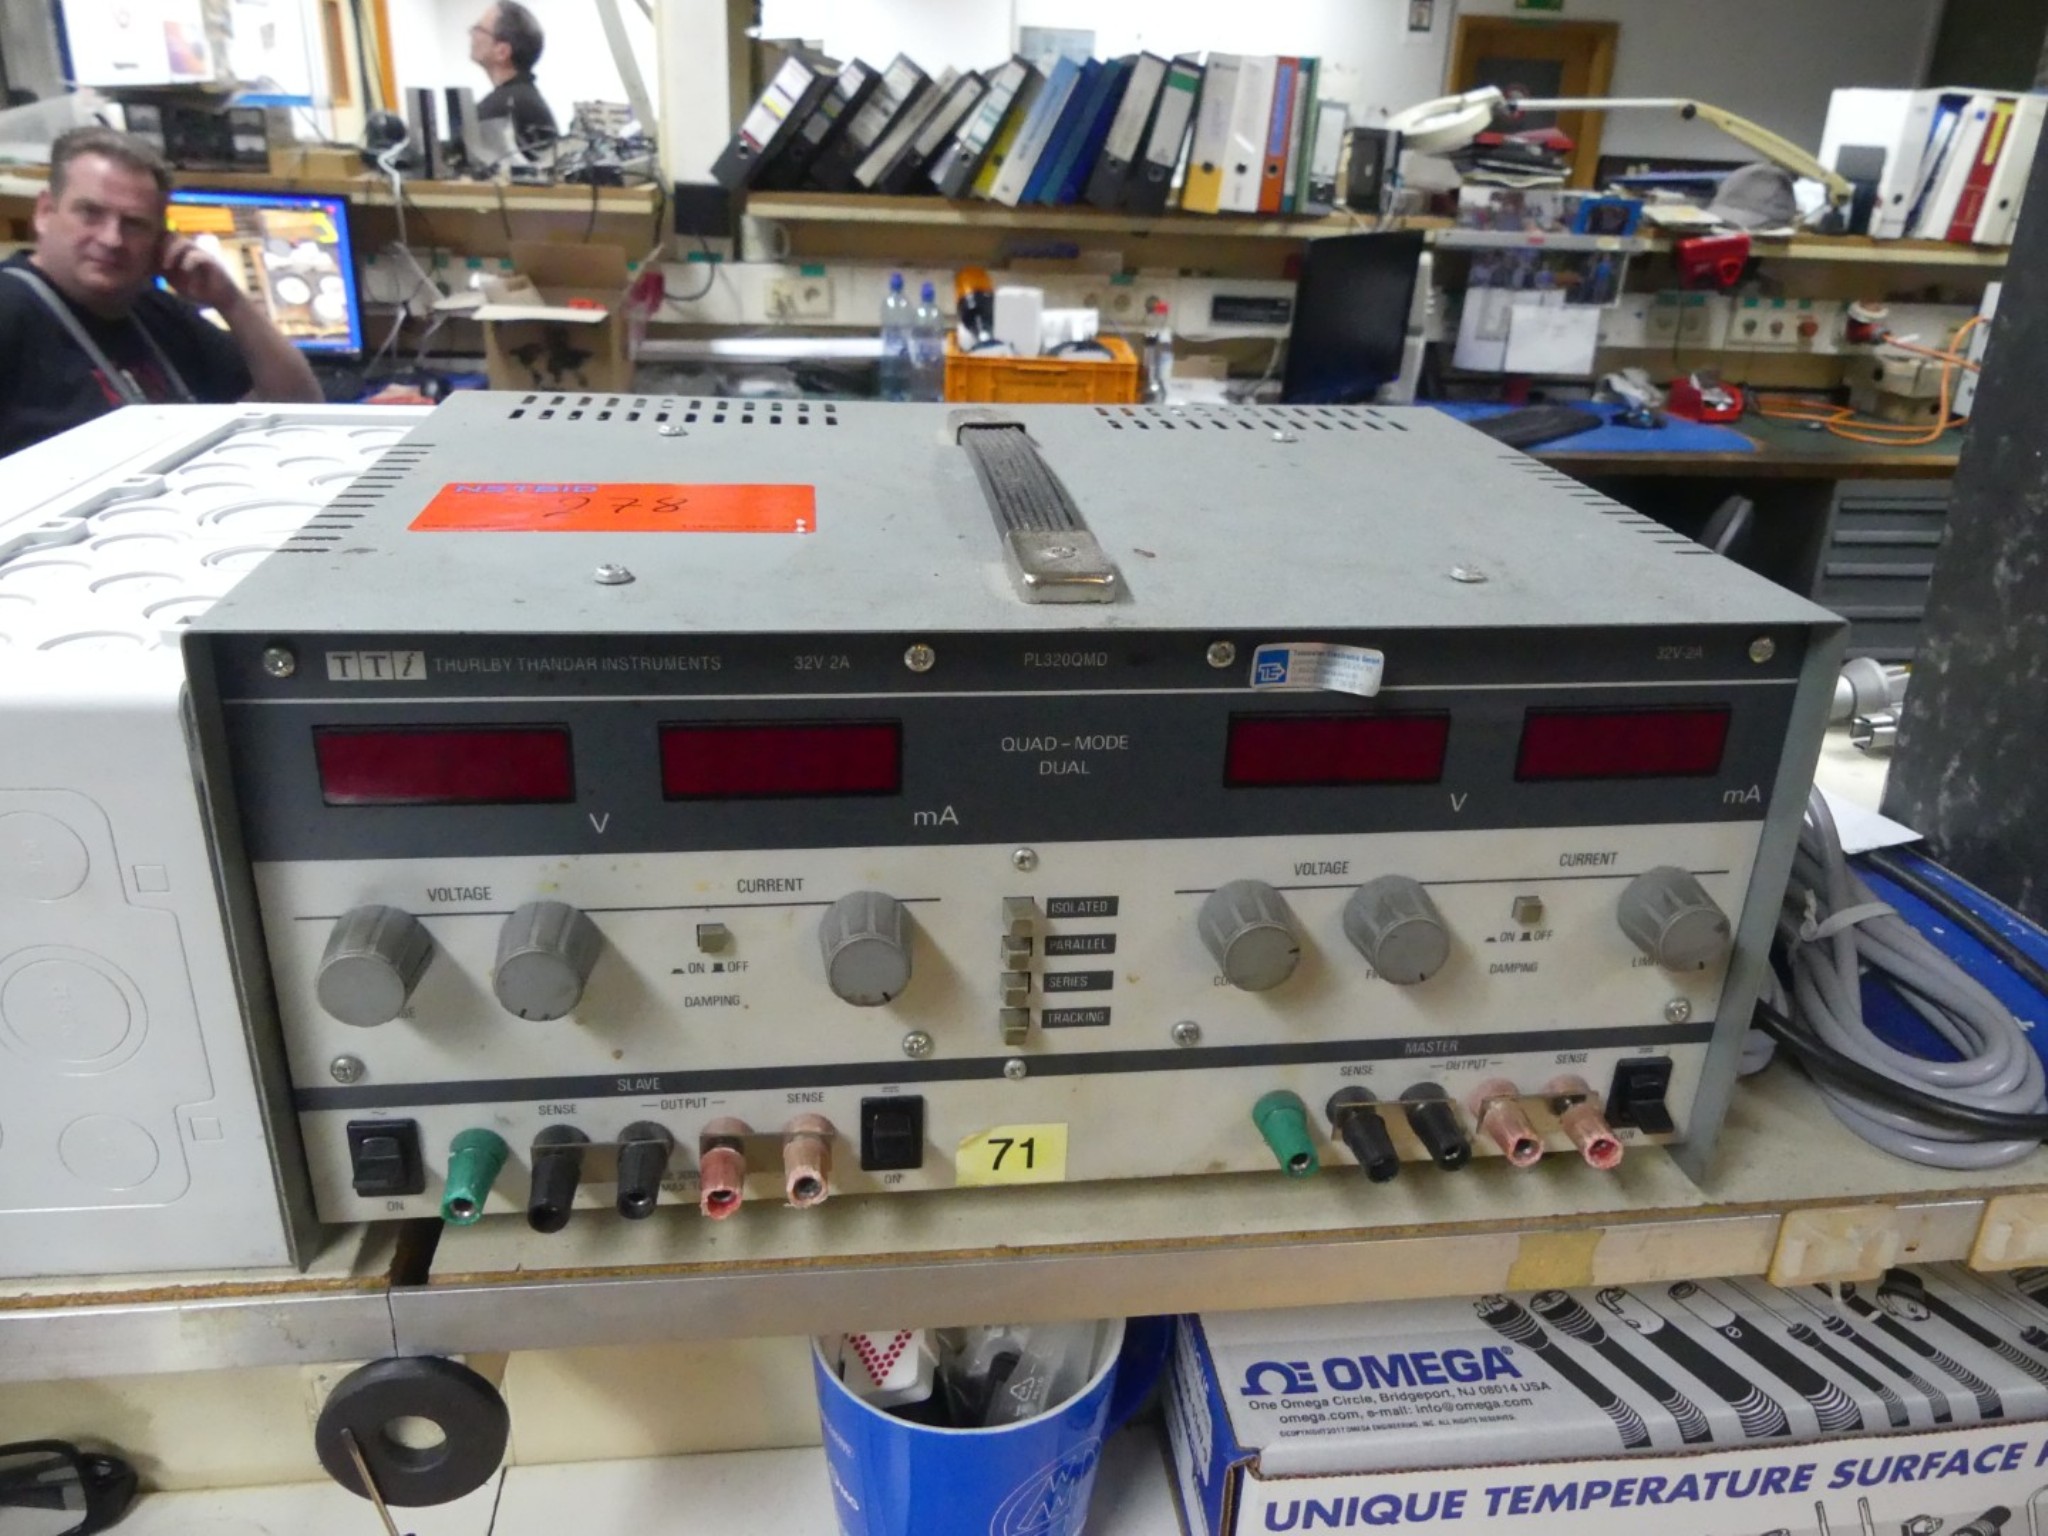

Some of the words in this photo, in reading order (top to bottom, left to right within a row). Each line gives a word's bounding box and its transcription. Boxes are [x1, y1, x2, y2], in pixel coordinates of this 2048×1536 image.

[433, 656, 513, 673] THURLBY
[516, 656, 599, 672] THANDAR
[602, 655, 721, 672] INSTRUMENTS
[794, 655, 824, 670] 32V
[829, 654, 850, 670] 2A
[1023, 651, 1108, 668] PL320QMD
[1039, 760, 1091, 776] DUAL
[1722, 784, 1761, 803] mA
[1450, 792, 1468, 812] V
[589, 812, 610, 834] V
[913, 805, 959, 826] mA
[1559, 851, 1619, 867] CURRENT
[1293, 860, 1350, 876] VOLTAGE
[736, 877, 805, 893] CURRENT
[427, 886, 493, 902] VOLTAGE
[1050, 901, 1108, 914] ISOLATED
[1050, 937, 1108, 950] PARALLEL
[1500, 931, 1515, 943] ON
[1533, 929, 1554, 941] OFF
[687, 961, 706, 974] ON
[726, 960, 749, 973] OFF
[1489, 961, 1538, 975] DAMPING
[1049, 976, 1089, 988] SERIES
[684, 994, 741, 1008] DAMPING
[1047, 1011, 1105, 1024] TRACKING
[1404, 1039, 1459, 1054] MASTER
[1445, 1058, 1488, 1071] OUTPUT
[1555, 1053, 1589, 1065] SENSE
[1340, 1064, 1375, 1077] SENSE
[617, 1077, 661, 1092] SLAVE
[660, 1097, 708, 1110] OUTPUT
[786, 1091, 826, 1104] SENSE
[538, 1104, 578, 1116] SENSE
[987, 1136, 1035, 1171] 71
[386, 1200, 405, 1212] ON
[1249, 1399, 1278, 1410] One
[1280, 1398, 1329, 1411] Omega
[1332, 1394, 1377, 1406] Circle,
[1379, 1389, 1456, 1403] Bridgeport,
[1458, 1387, 1476, 1397] NJ
[1478, 1383, 1518, 1396] 08014
[1520, 1381, 1552, 1392] USA
[1279, 1411, 1365, 1424] omega.com,
[1366, 1407, 1412, 1419] e-mail:
[1415, 1397, 1534, 1414] info@omega.com
[1264, 1489, 1468, 1532] UNIQUE
[1484, 1463, 1817, 1518] TEMPERATURE
[1827, 1441, 2029, 1490] SURFACE
